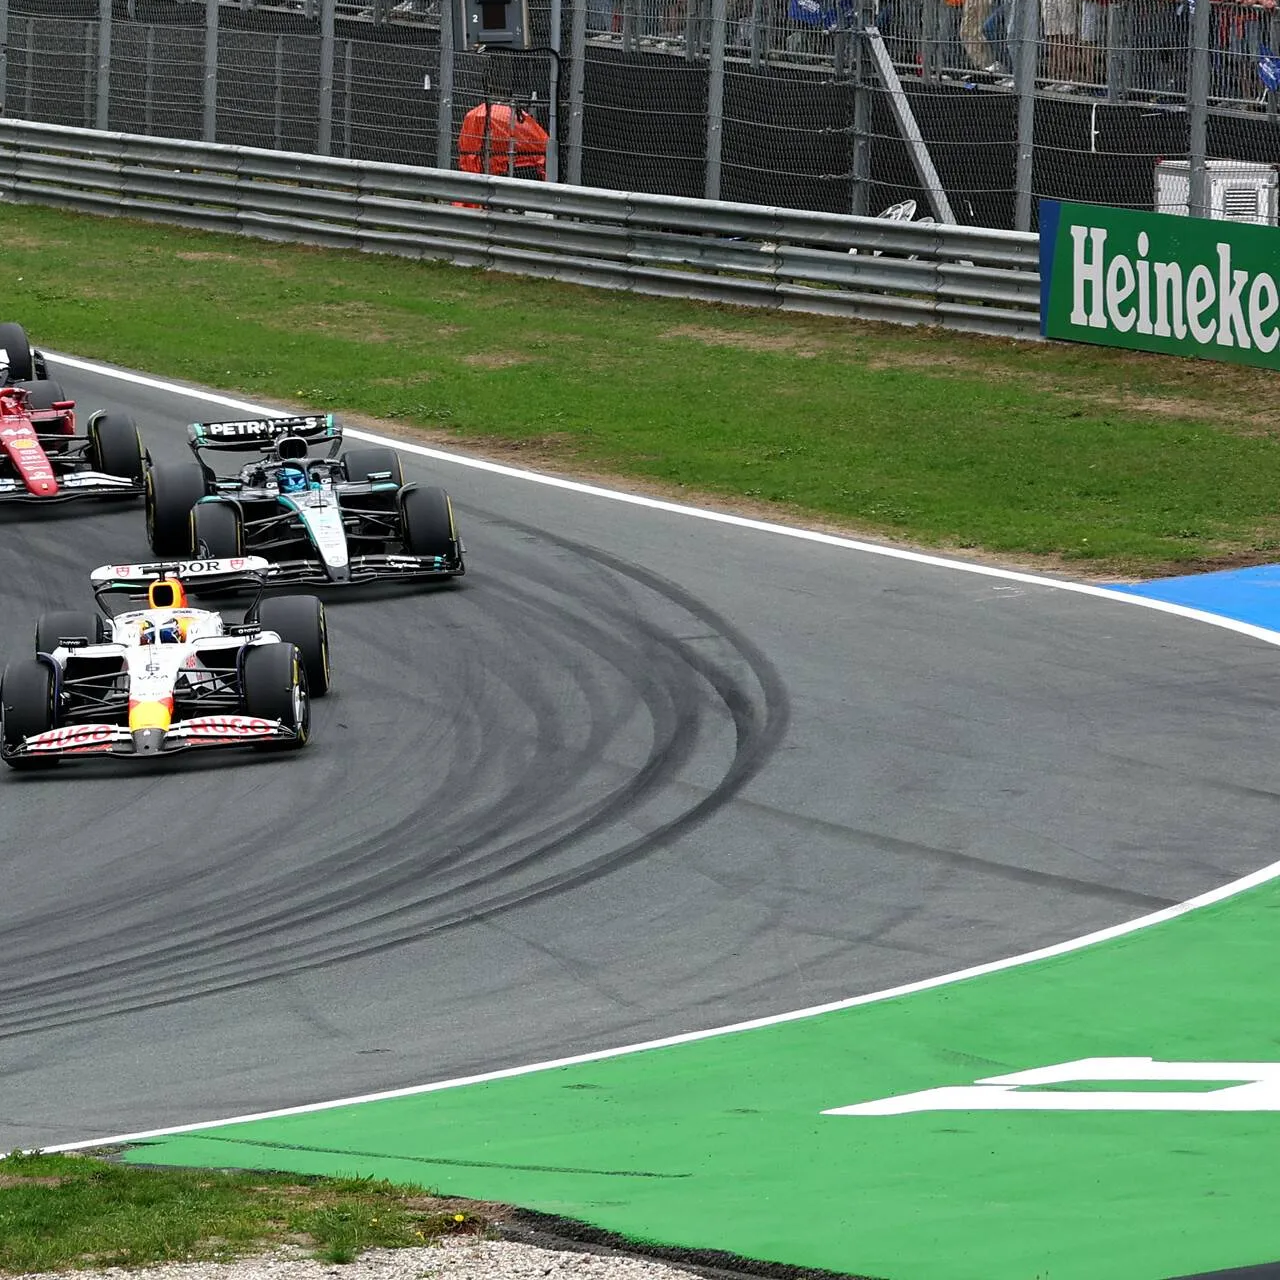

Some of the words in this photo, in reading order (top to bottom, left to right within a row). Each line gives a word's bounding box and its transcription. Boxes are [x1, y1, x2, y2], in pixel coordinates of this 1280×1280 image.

[146, 663, 160, 671] 6
[190, 718, 269, 734] HUGO
[39, 726, 111, 747] HUGO
